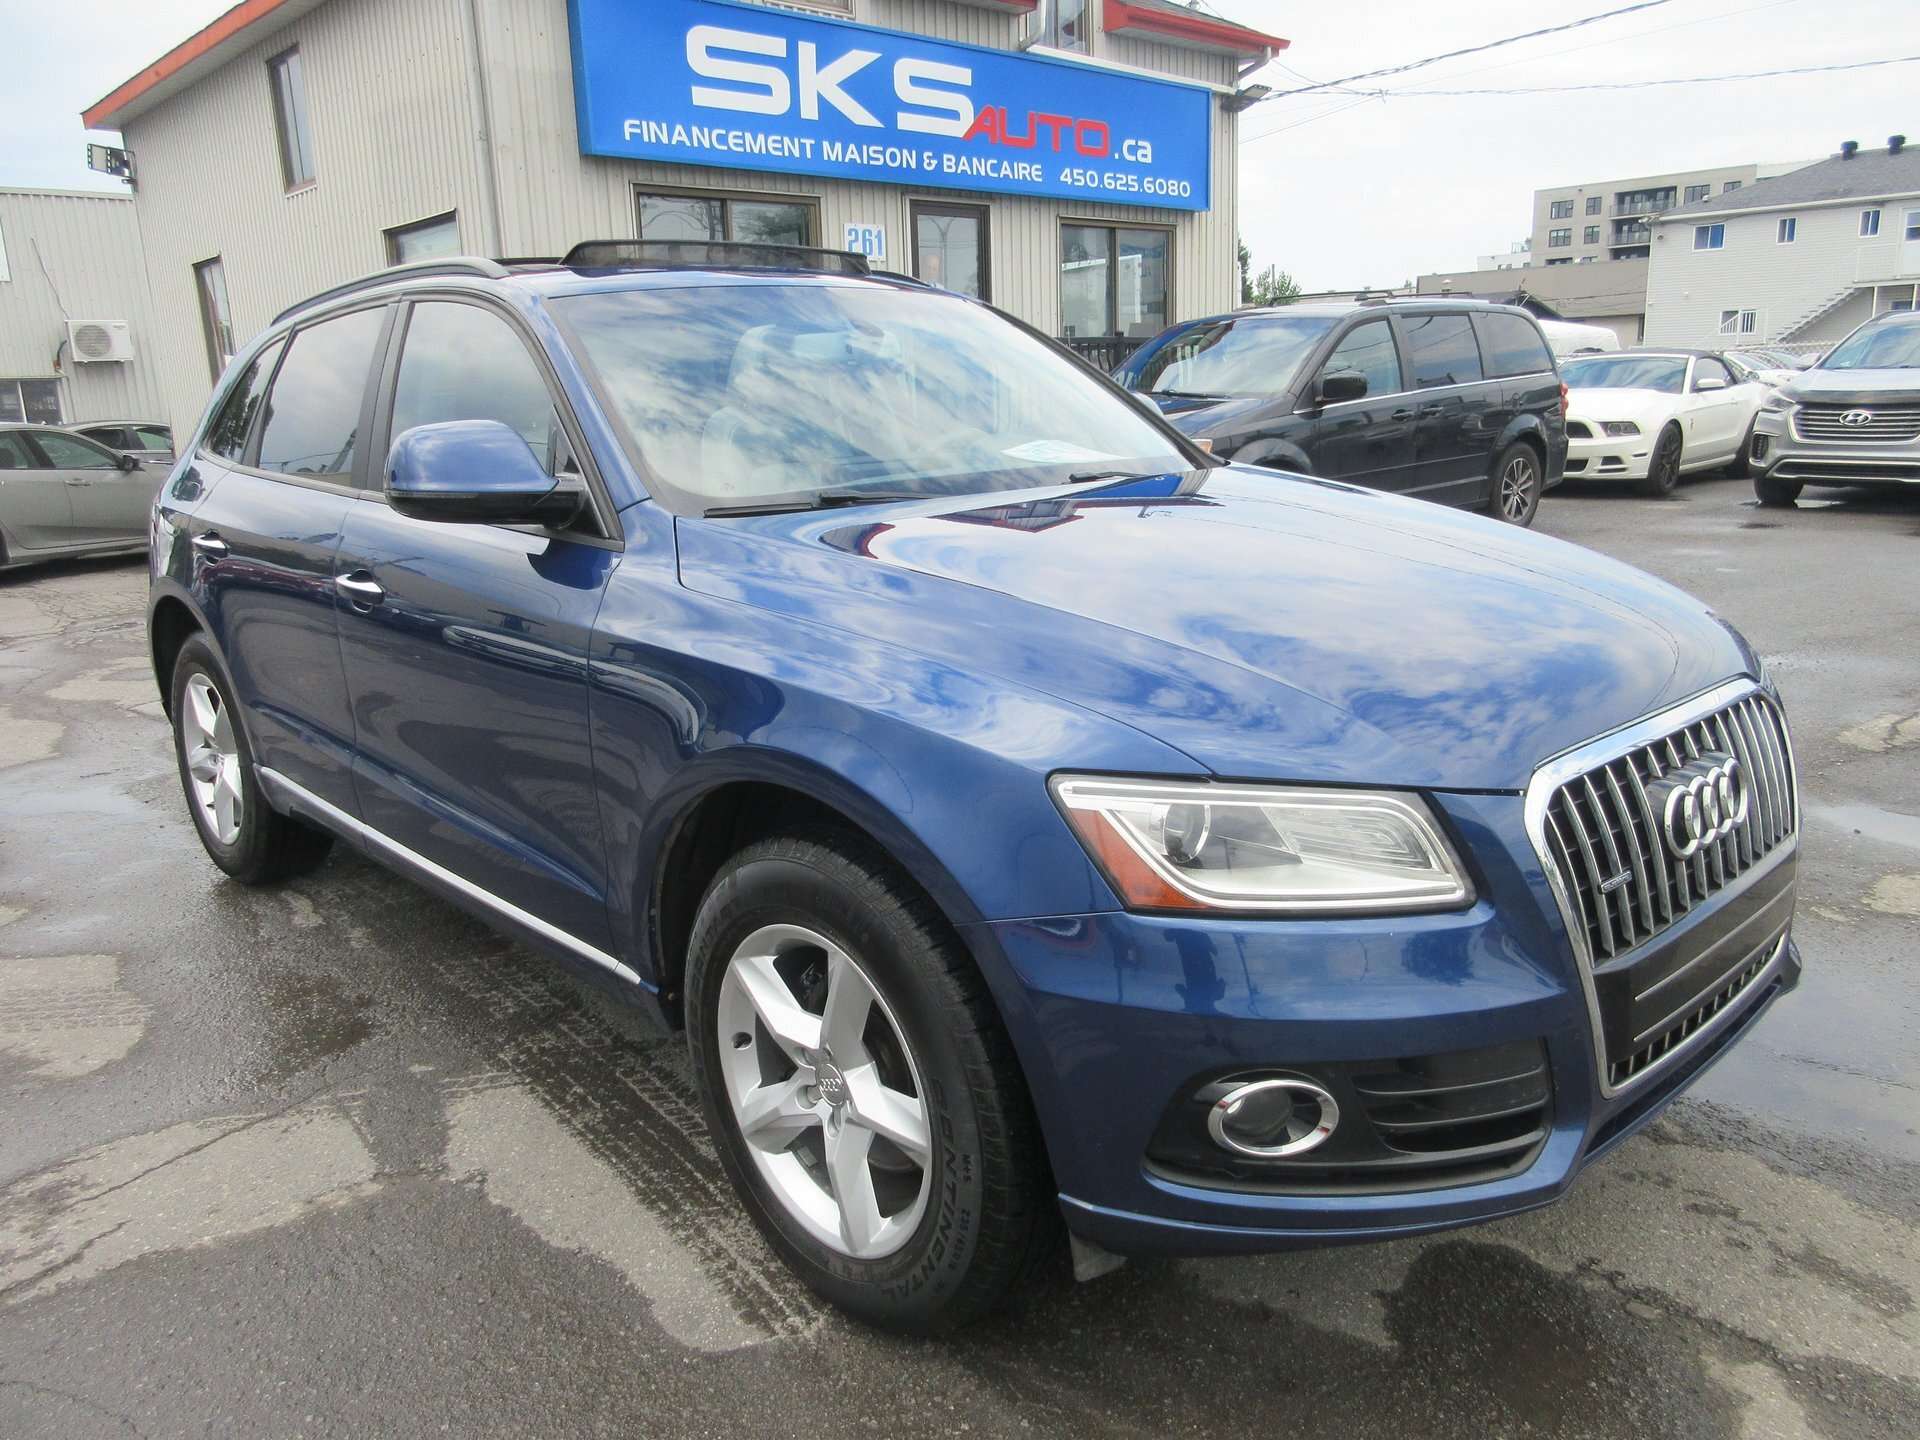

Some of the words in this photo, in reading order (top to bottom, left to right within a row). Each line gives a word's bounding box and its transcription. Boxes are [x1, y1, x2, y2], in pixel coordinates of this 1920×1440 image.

[623, 118, 816, 160] FINANCEMENT
[821, 140, 917, 170] MAISON
[922, 151, 938, 171] &
[942, 154, 1043, 182] BANCAIRE
[1059, 168, 1191, 198] 450.625.6080
[847, 227, 883, 257] 261
